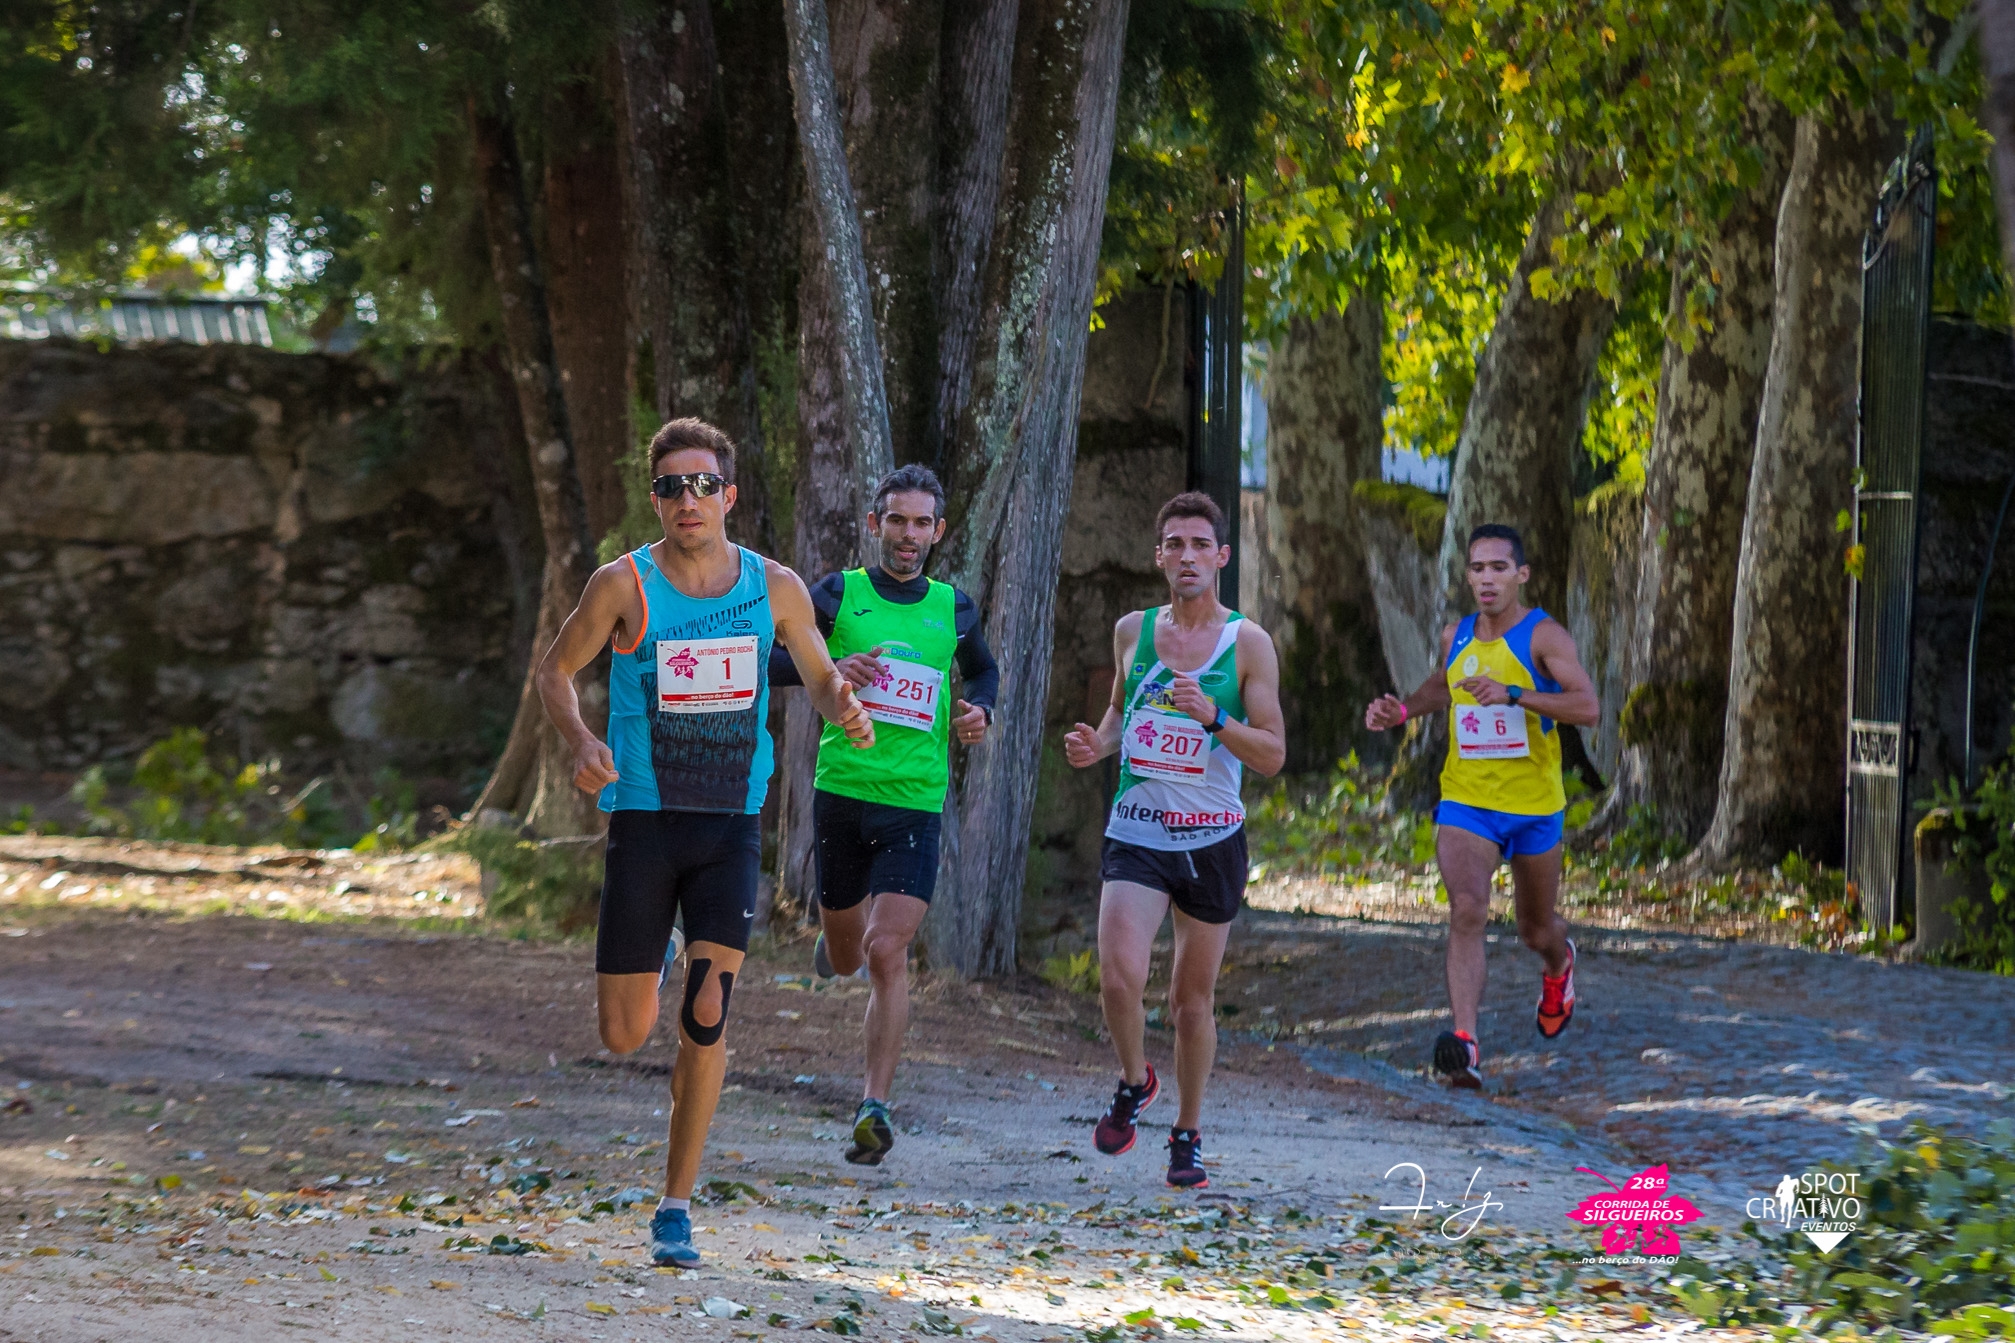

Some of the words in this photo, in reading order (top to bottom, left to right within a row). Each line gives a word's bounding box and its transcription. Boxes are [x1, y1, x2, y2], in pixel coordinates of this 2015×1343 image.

[720, 646, 736, 654] PEDRO
[737, 645, 753, 653] ROCHA
[722, 657, 731, 680] 1
[895, 678, 933, 704] 251
[1495, 719, 1507, 736] 6
[1160, 733, 1204, 757] 207
